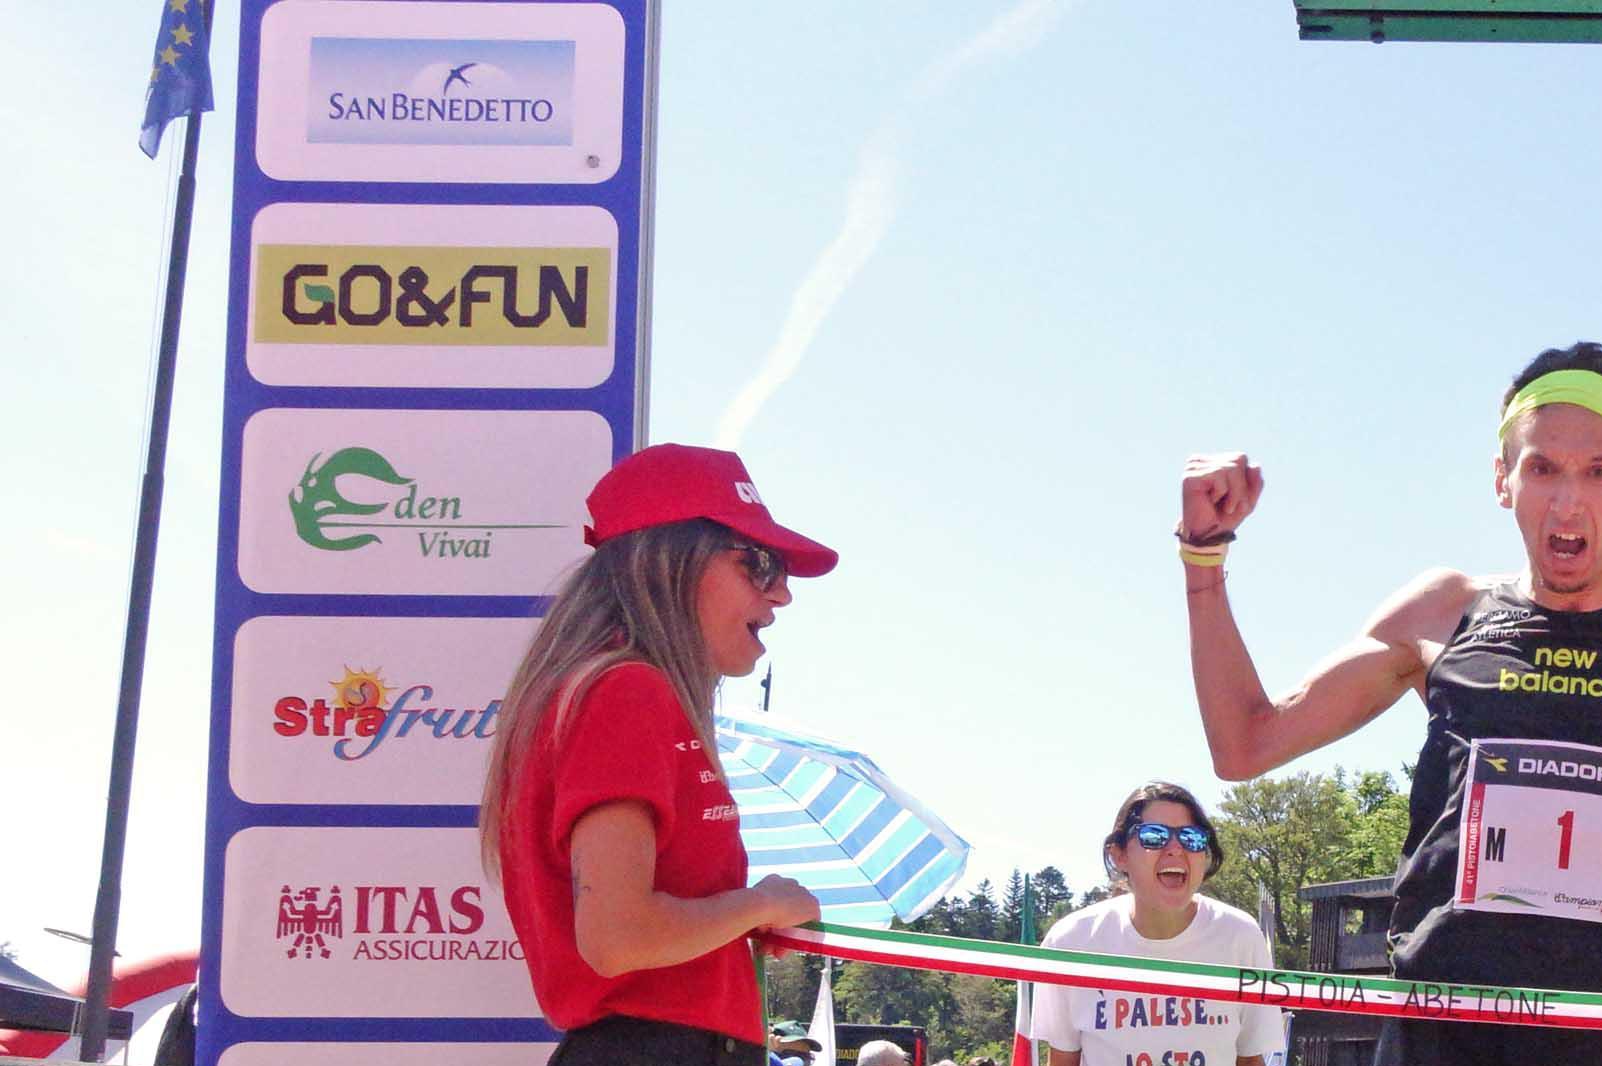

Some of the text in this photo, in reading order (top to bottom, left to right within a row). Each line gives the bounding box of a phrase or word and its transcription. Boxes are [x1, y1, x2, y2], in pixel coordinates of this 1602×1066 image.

[281, 264, 589, 328] GO&FUN
[418, 531, 492, 558] Vivai
[1534, 647, 1598, 670] new
[1485, 810, 1575, 870] M 1
[353, 886, 485, 935] ITAS
[353, 939, 528, 961] ASSICURAZIO
[1095, 990, 1229, 1029] È PALESE...
[1237, 967, 1368, 1008] PISTOIA
[1400, 982, 1561, 1024] ABETONE
